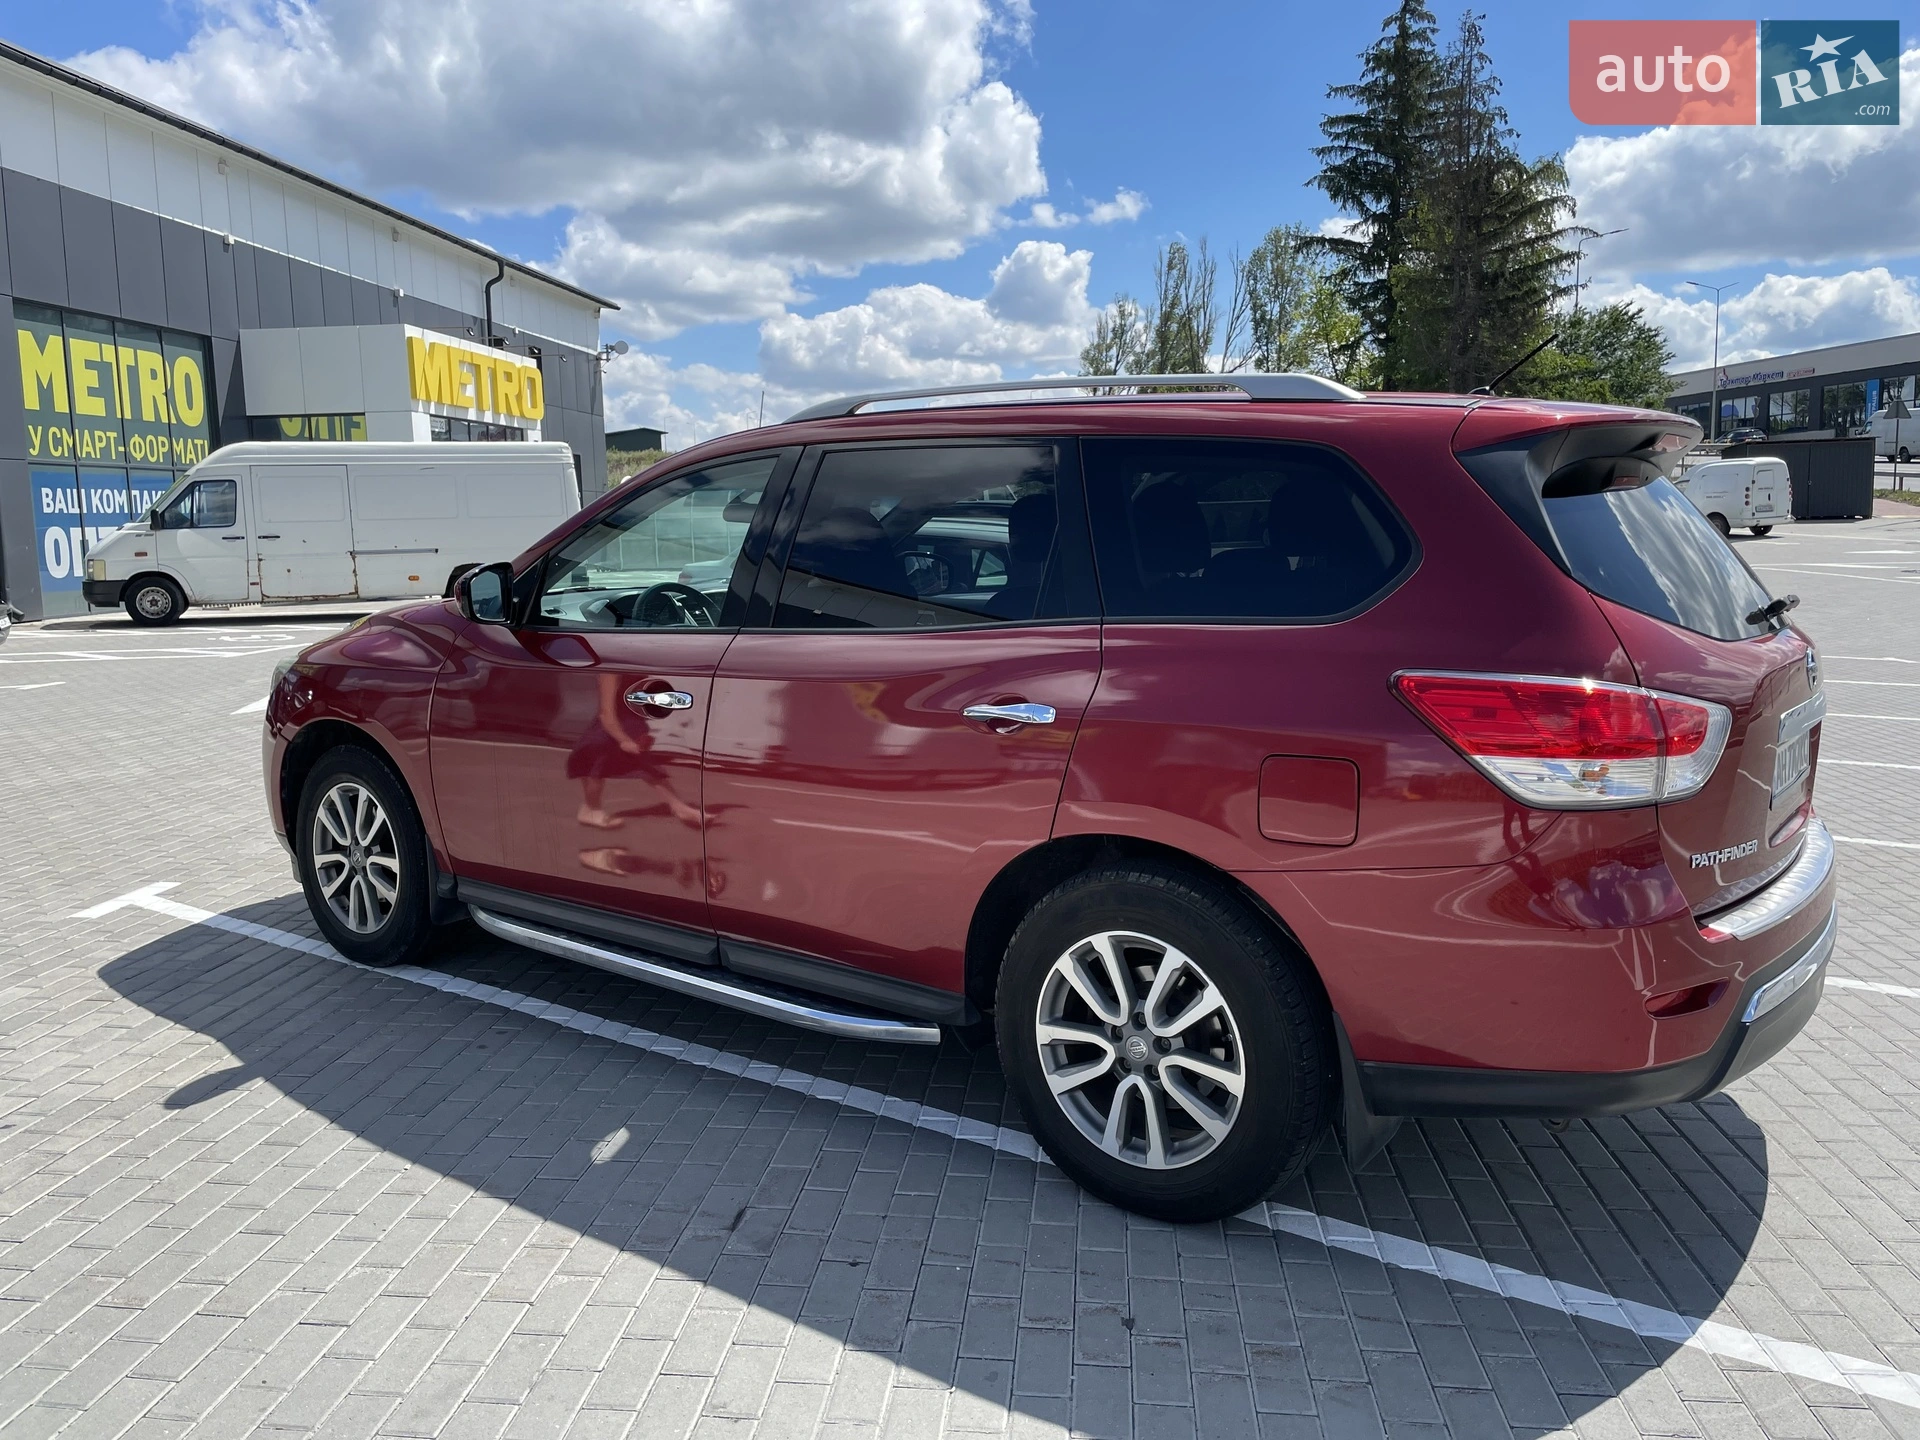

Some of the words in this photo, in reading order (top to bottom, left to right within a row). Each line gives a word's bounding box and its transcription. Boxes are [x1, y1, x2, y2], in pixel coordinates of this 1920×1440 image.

[17, 329, 205, 427] METRO
[407, 336, 544, 420] METRO
[28, 425, 42, 456] У
[41, 487, 87, 515] ВАШ
[1690, 839, 1758, 869] PATHFINDER
